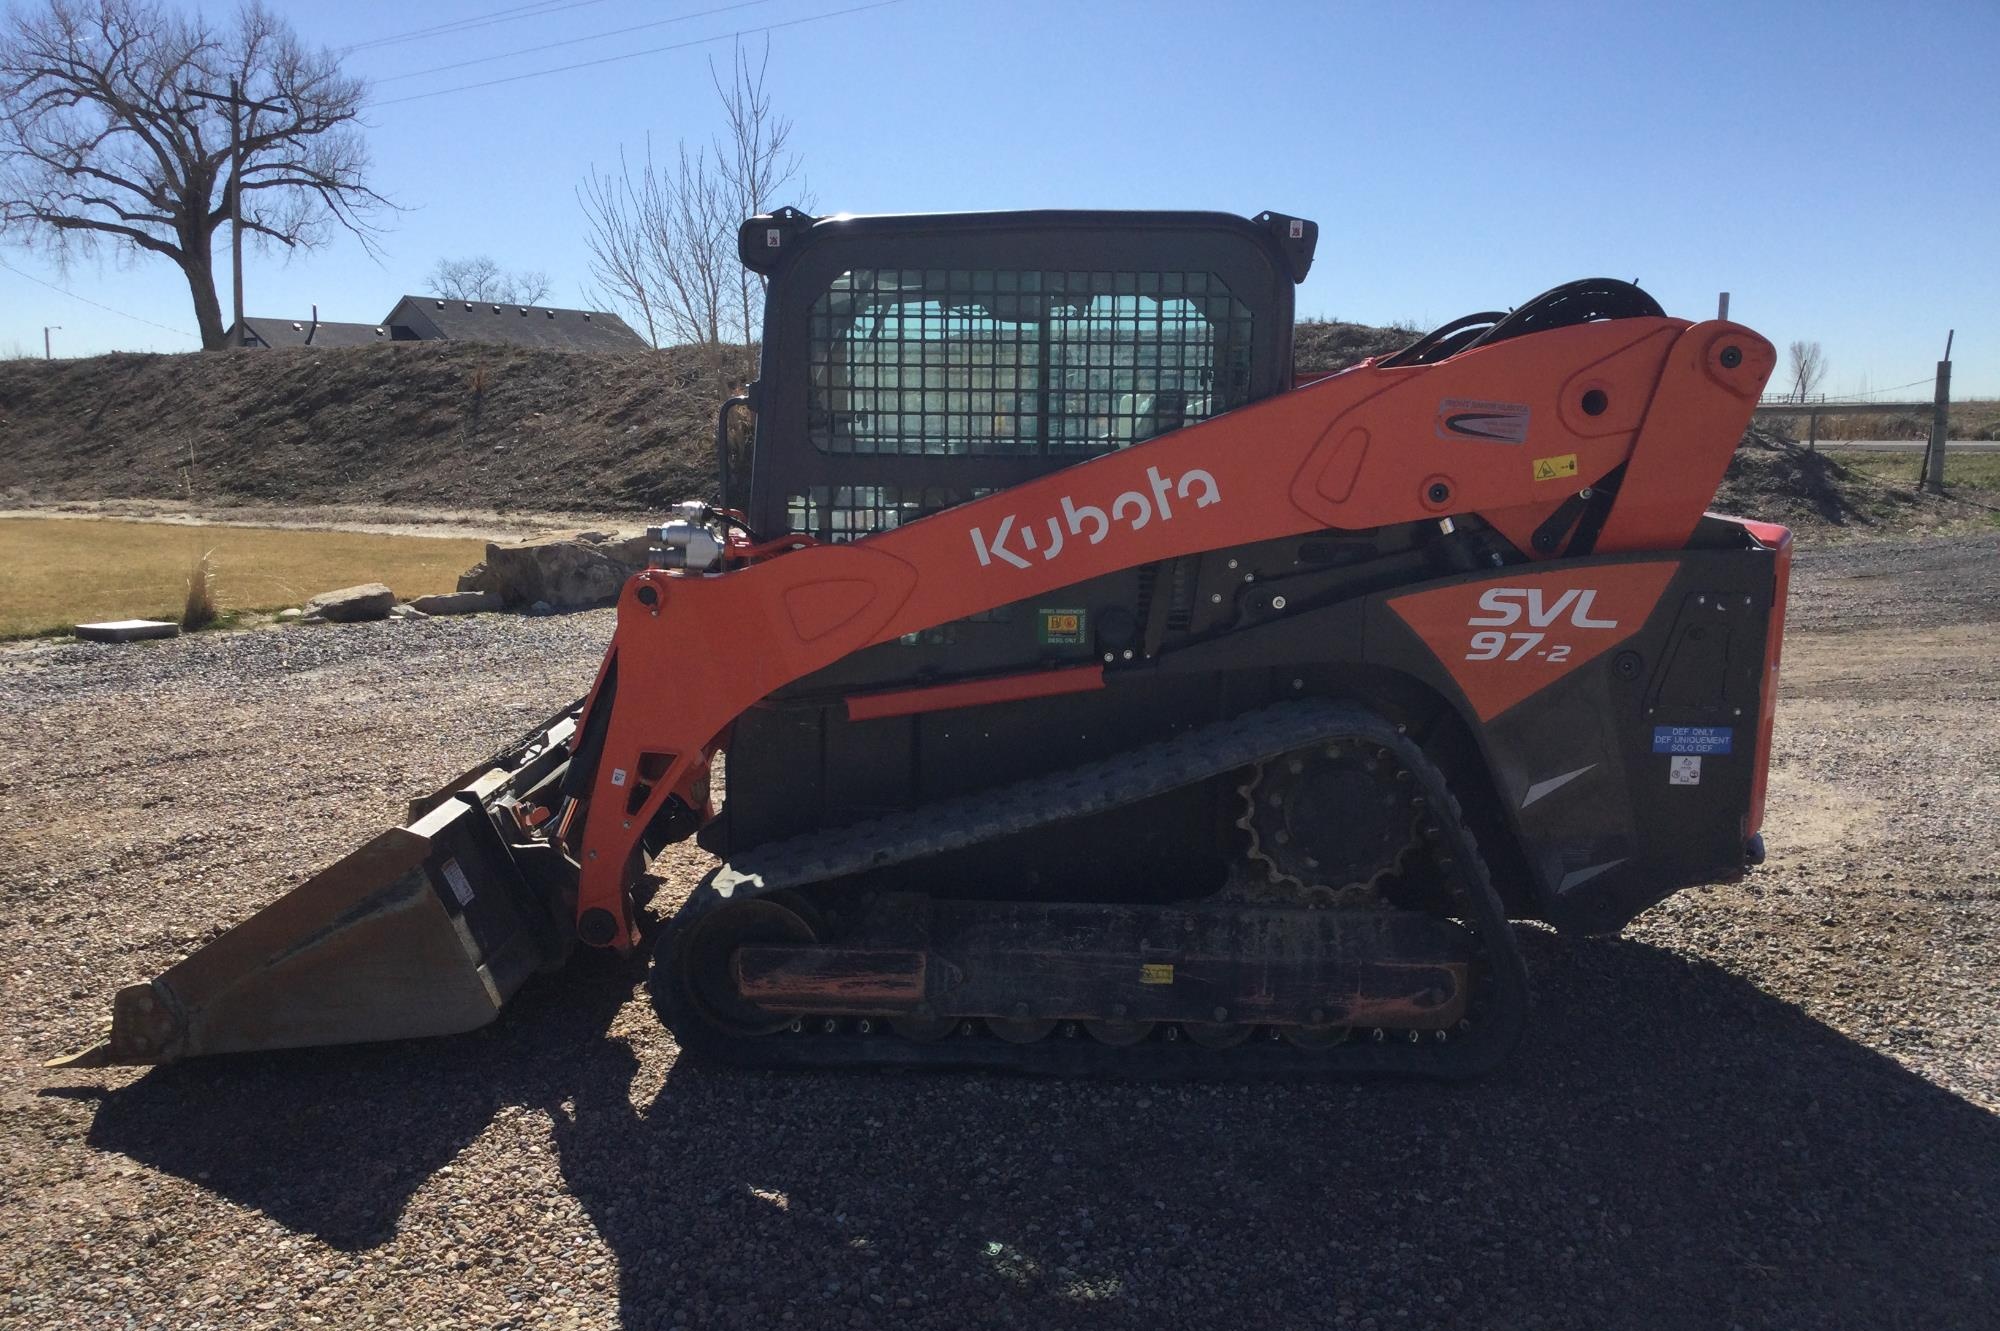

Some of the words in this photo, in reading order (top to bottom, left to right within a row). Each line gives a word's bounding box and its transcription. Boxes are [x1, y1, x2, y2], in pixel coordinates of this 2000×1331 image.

[970, 466, 1221, 569] Kubota
[1467, 587, 1618, 629] SVL
[1465, 631, 1571, 662] 97-2
[1655, 735, 1671, 744] DEF
[1674, 736, 1730, 744] UNIQUEMENT
[1672, 727, 1689, 736] DEF
[1692, 728, 1714, 736] ONLY
[1671, 744, 1694, 752] SOLO
[1696, 744, 1713, 752] DEF
